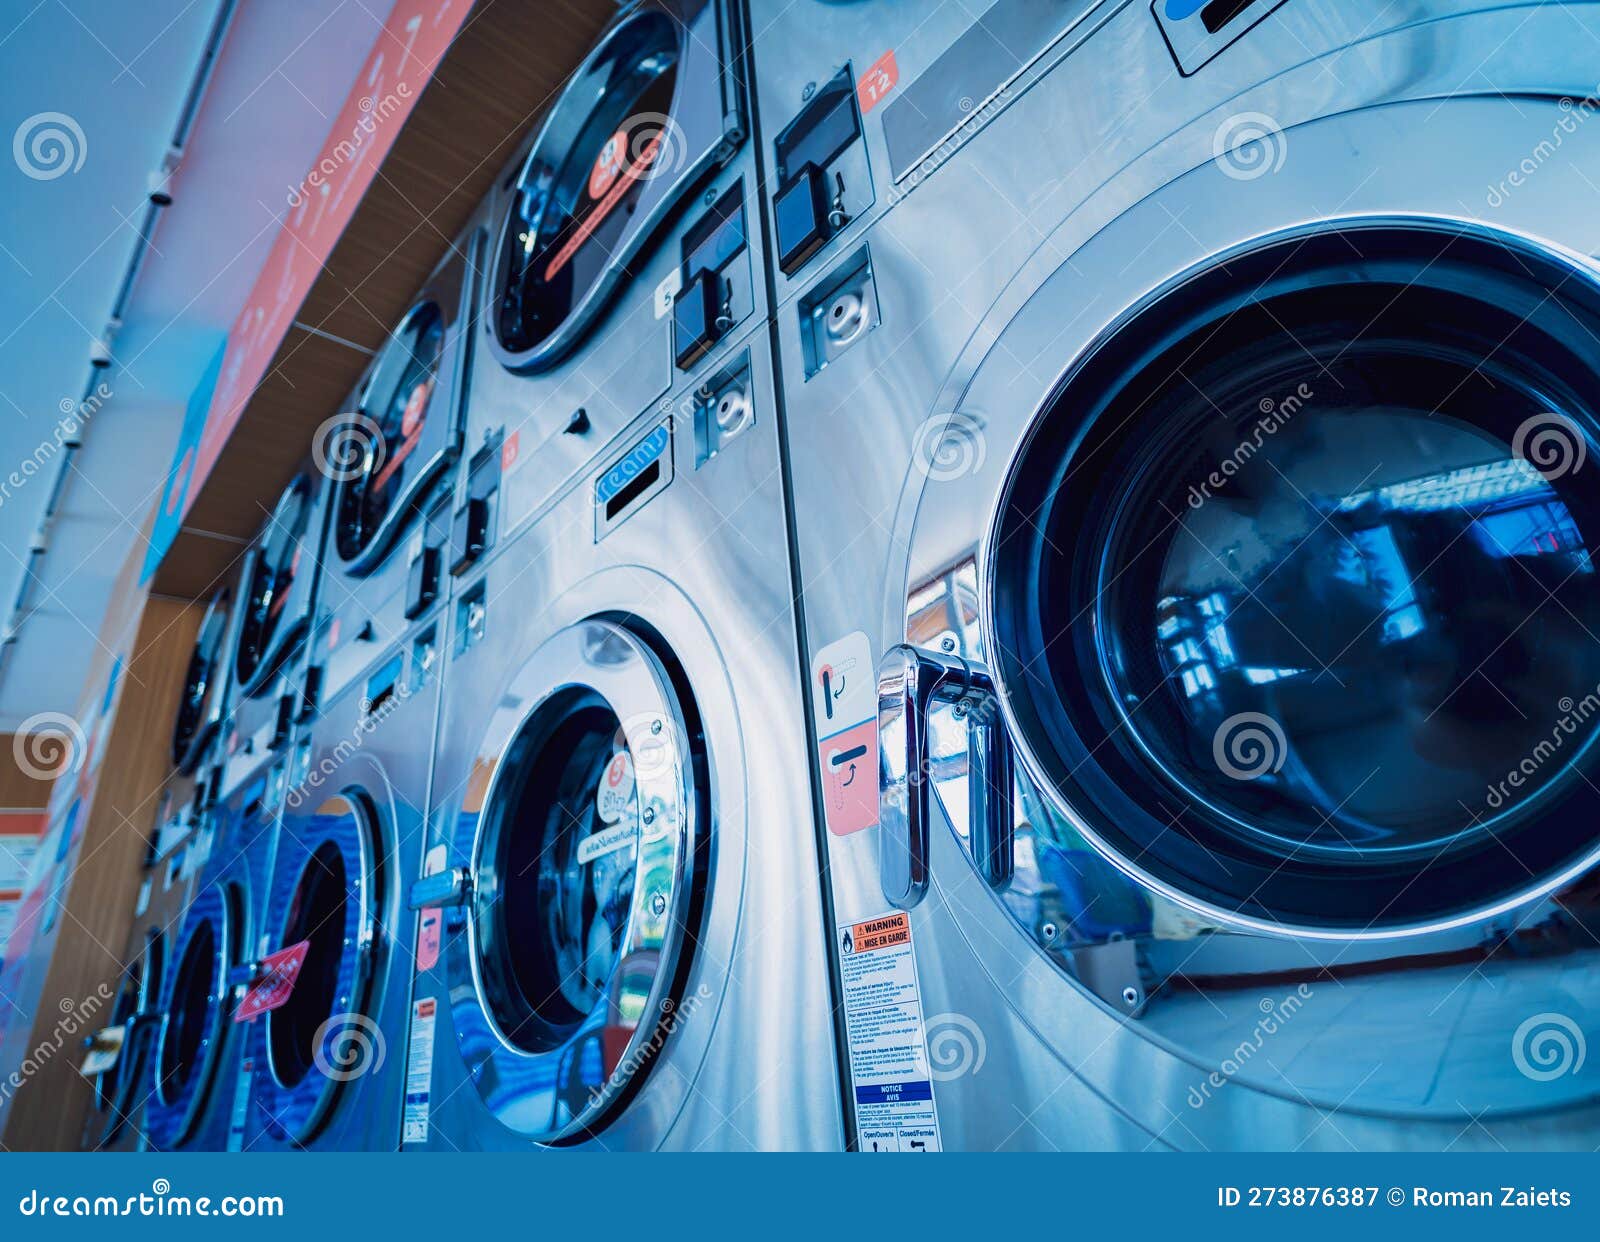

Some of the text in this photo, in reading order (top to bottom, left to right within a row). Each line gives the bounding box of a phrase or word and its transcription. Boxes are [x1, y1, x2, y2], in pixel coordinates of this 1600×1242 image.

[868, 73, 890, 100] 12
[664, 291, 671, 306] 5
[864, 917, 904, 933] WARNING
[864, 931, 907, 949] MISE EN GARDE
[880, 1084, 903, 1093] NOTICE
